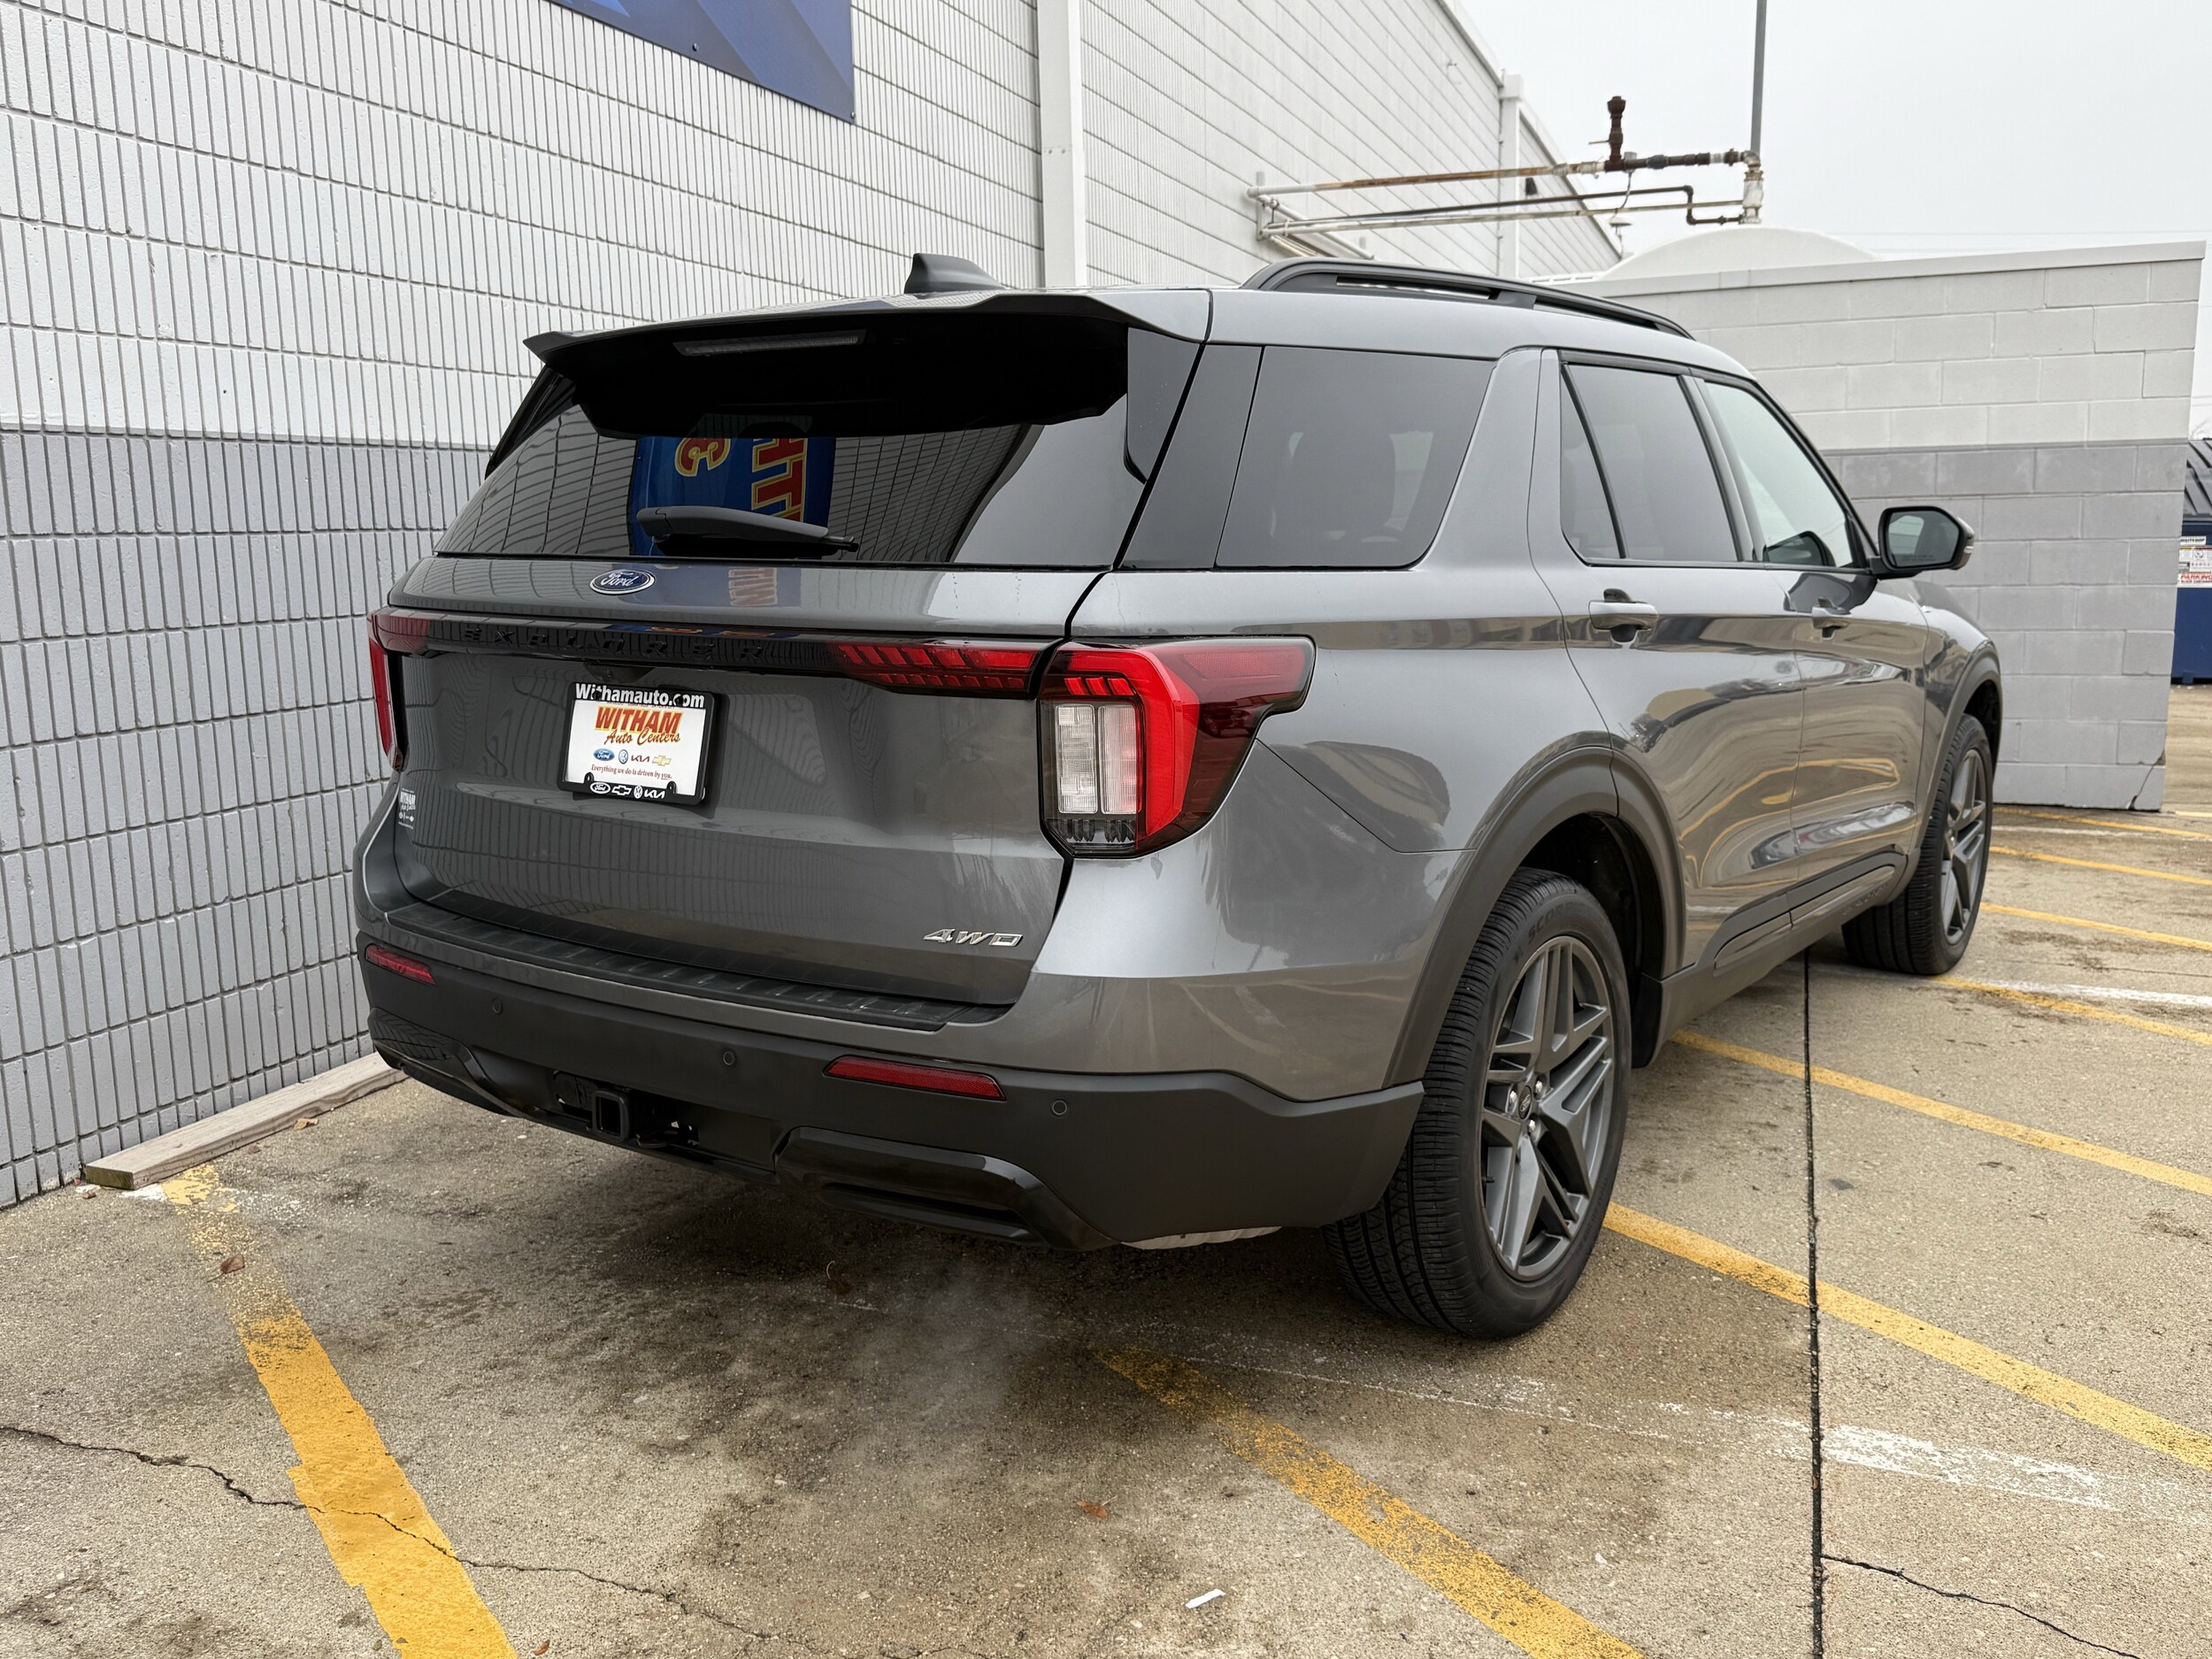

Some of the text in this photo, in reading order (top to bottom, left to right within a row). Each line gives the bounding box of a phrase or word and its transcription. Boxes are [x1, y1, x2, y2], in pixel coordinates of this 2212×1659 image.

[595, 705, 683, 734] WITHAM
[603, 726, 681, 745] Auto Centers
[591, 764, 617, 774] Everything
[655, 771, 660, 780] by
[923, 928, 1024, 947] 4WD
